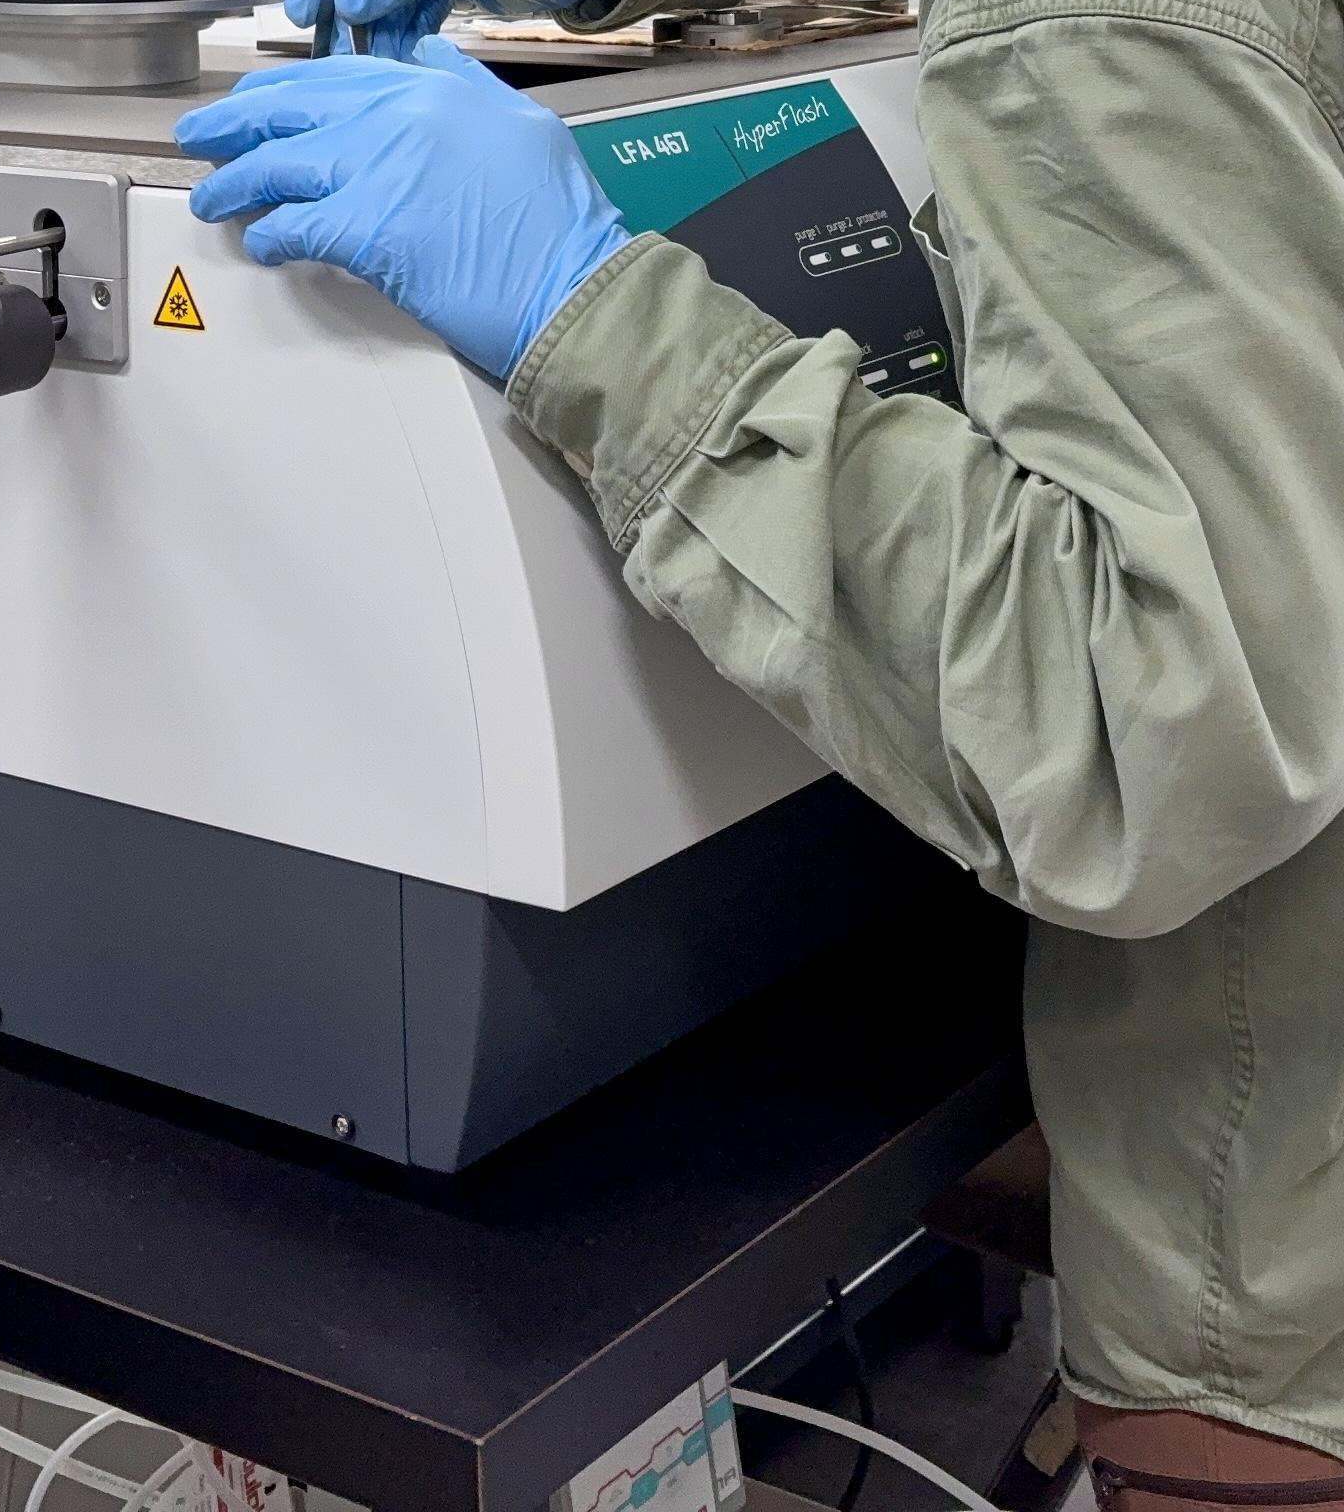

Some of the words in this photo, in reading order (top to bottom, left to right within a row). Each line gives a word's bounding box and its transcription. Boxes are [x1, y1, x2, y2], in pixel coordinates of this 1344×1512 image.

[733, 95, 830, 153] HyperFlash
[611, 138, 656, 165] LFA
[653, 130, 690, 156] 467
